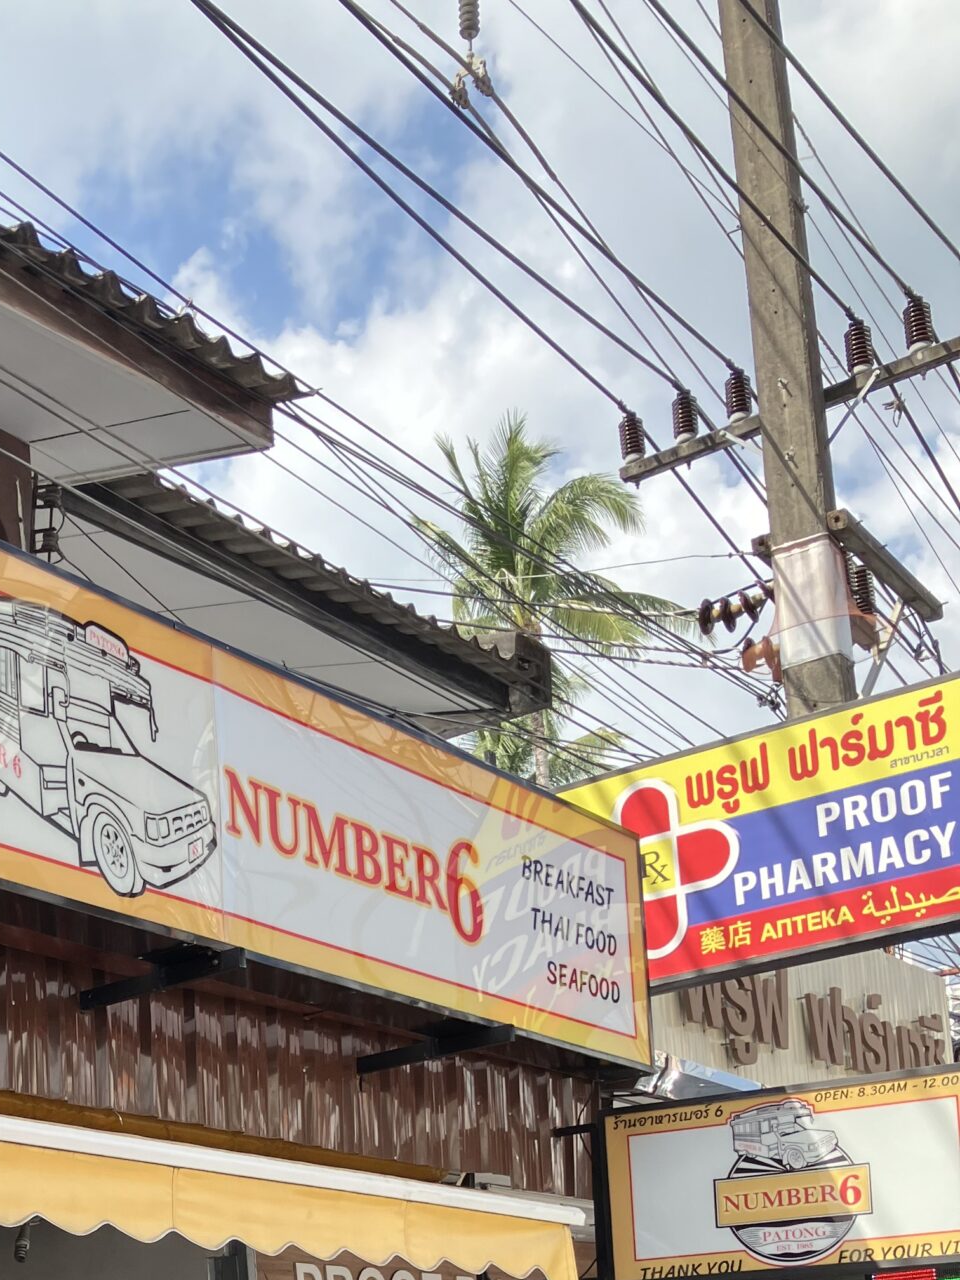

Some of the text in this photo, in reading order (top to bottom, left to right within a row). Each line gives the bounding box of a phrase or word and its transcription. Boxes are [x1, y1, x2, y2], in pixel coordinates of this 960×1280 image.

[685, 690, 947, 814] พรูฟ ฟาร์มาซี
[816, 771, 954, 837] PROOF
[521, 855, 614, 910] BREAKFAST
[733, 821, 957, 906] PHARMACY
[531, 908, 617, 956] THAI FOOD
[547, 960, 621, 1004] SEAFOOD
[814, 1089, 854, 1103] OPEN:
[857, 1081, 907, 1098] 8.30AM
[761, 1226, 827, 1243] PATONG
[838, 1249, 874, 1264] FOR
[881, 1243, 932, 1260] YOUR
[640, 1259, 743, 1280] THANK YOU
